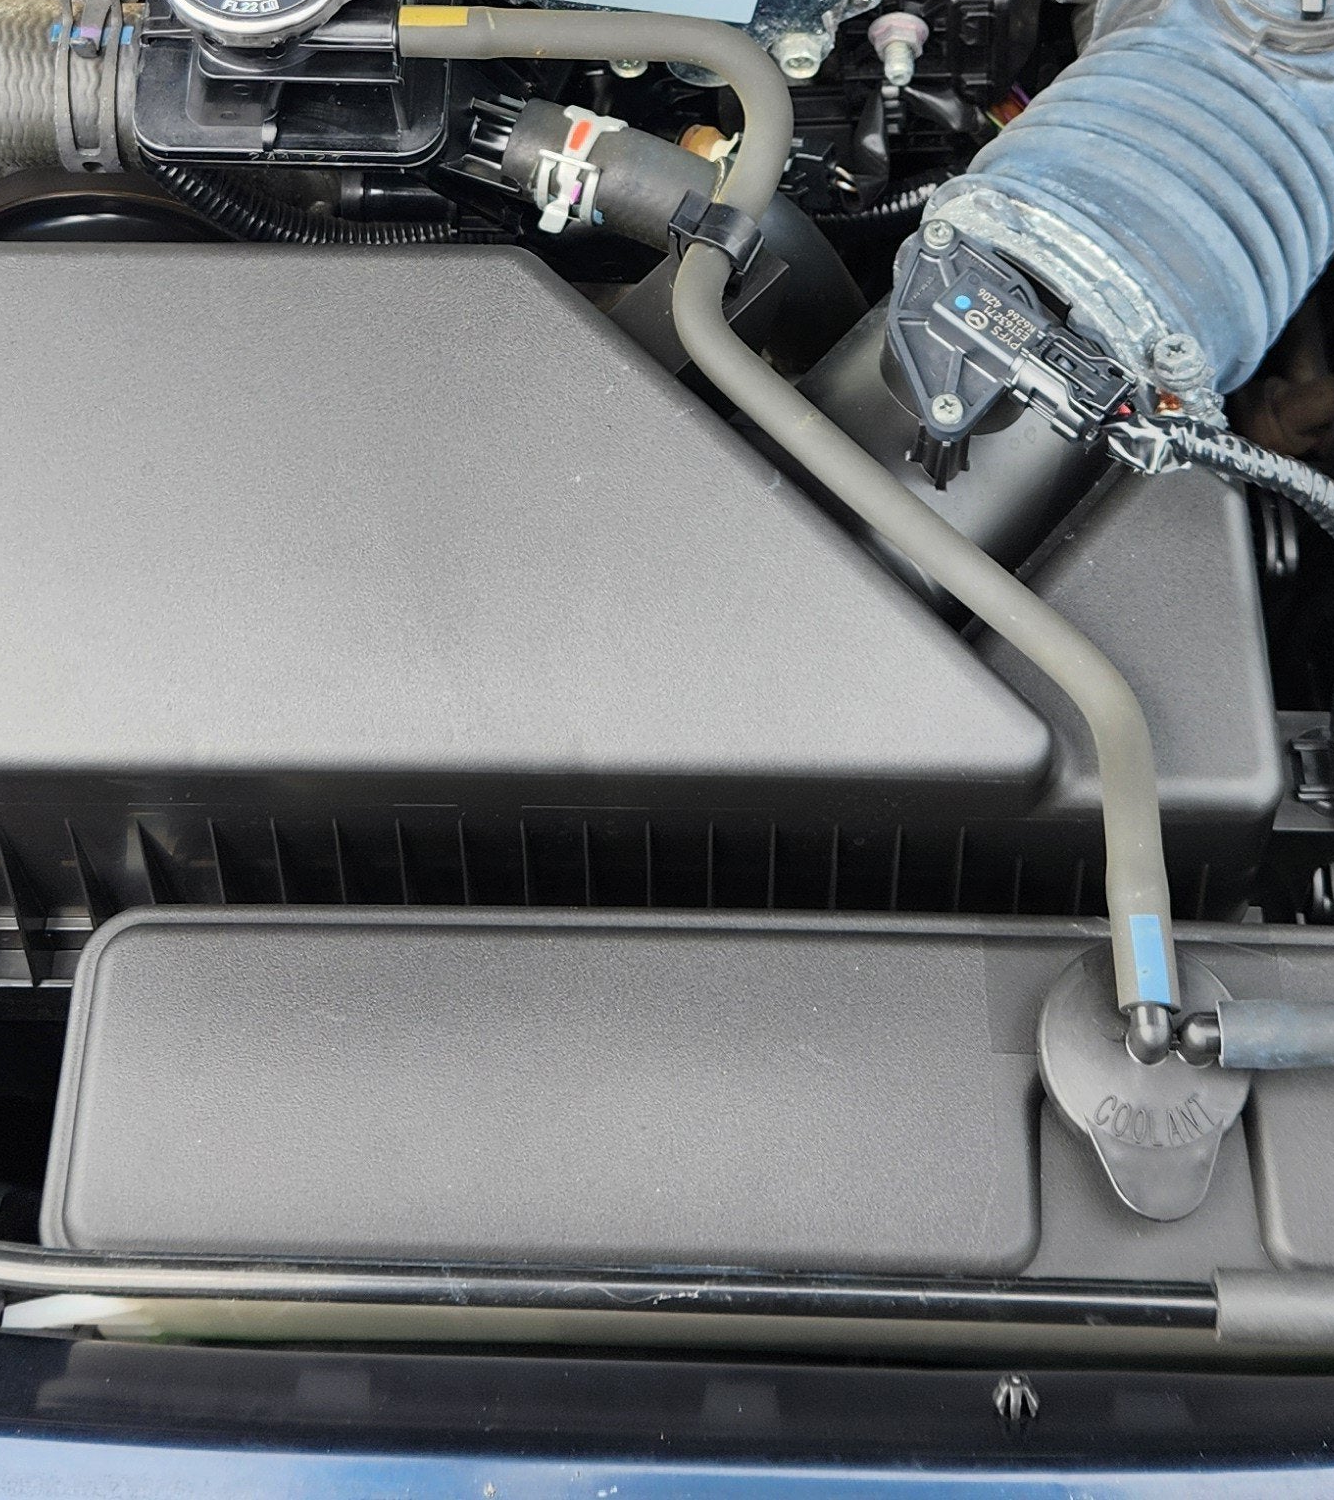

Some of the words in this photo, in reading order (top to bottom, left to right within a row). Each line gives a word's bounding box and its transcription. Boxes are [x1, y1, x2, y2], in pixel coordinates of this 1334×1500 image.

[221, 0, 259, 13] FL22
[983, 305, 1031, 342] E5T63271
[1007, 309, 1037, 334] K6266
[990, 326, 1022, 351] PYFS
[1093, 1094, 1215, 1148] COOLANT
